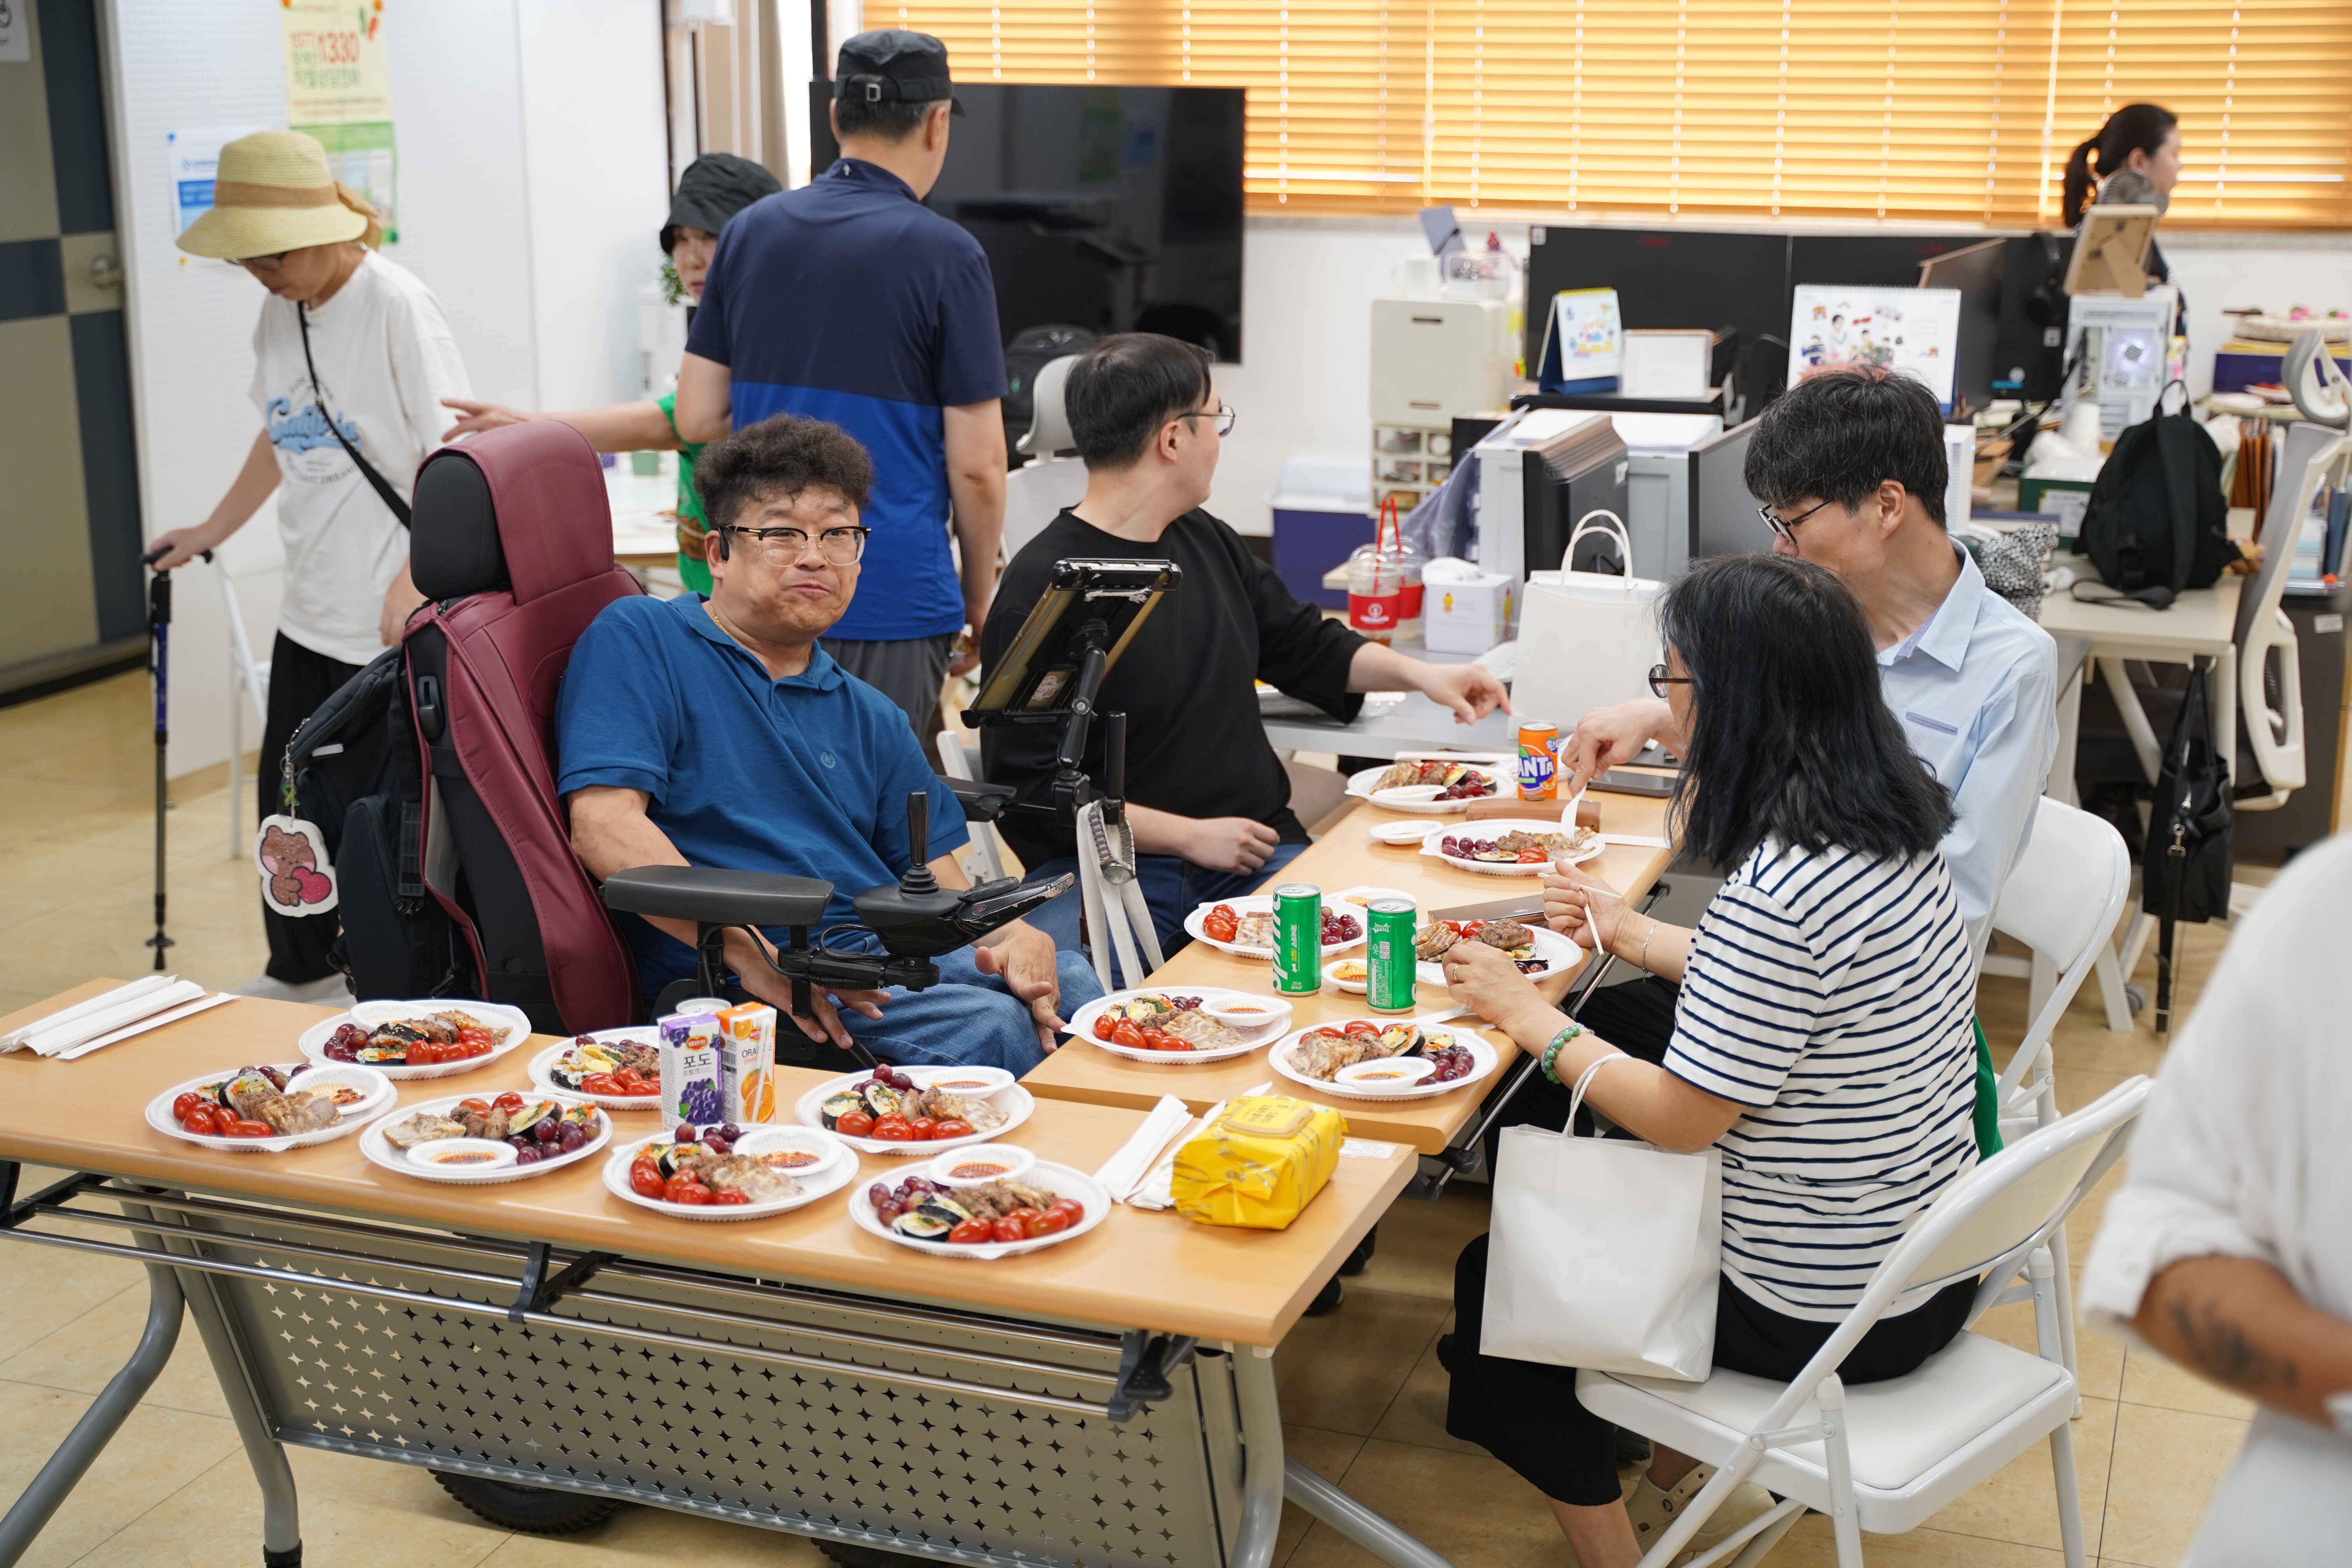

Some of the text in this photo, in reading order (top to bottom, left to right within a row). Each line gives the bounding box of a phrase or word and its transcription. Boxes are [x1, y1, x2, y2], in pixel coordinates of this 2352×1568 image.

[318, 31, 359, 62] 1330
[1519, 757, 1554, 777] ANTA
[683, 1053, 712, 1069] 포도
